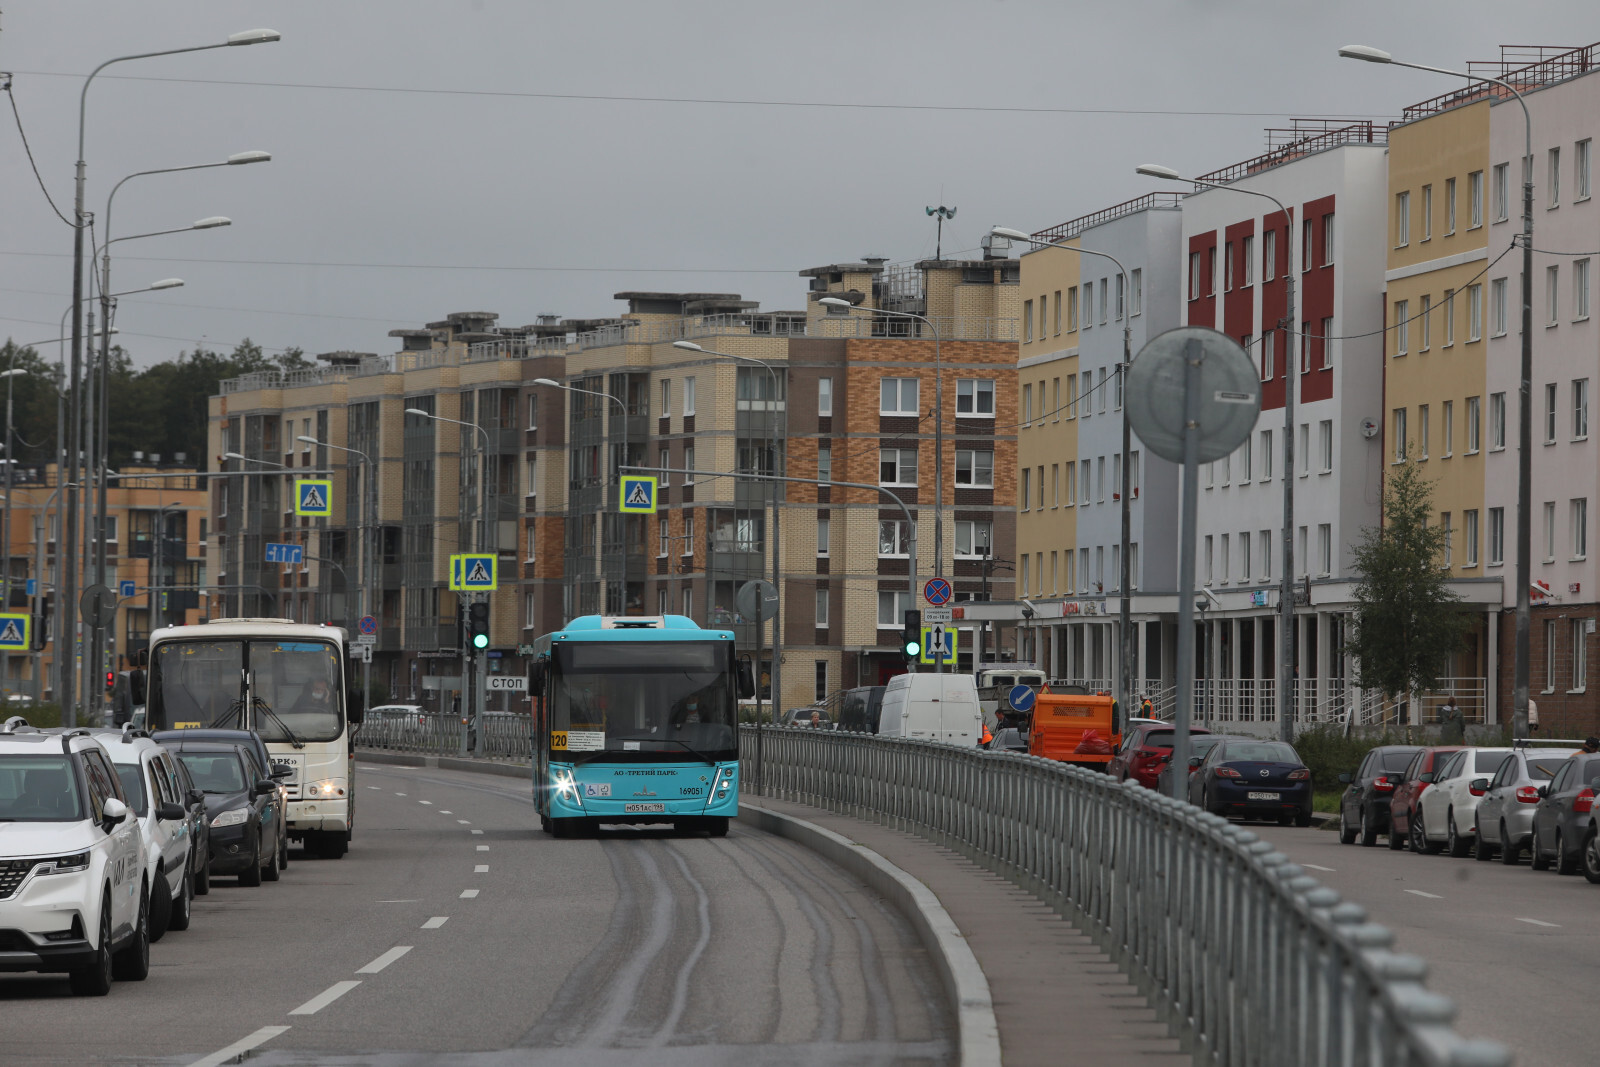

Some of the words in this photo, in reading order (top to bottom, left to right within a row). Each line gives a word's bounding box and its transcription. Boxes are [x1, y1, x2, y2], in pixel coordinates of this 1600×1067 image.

[492, 678, 523, 689] СТОП
[551, 734, 567, 747] 120
[679, 787, 703, 795] 169051
